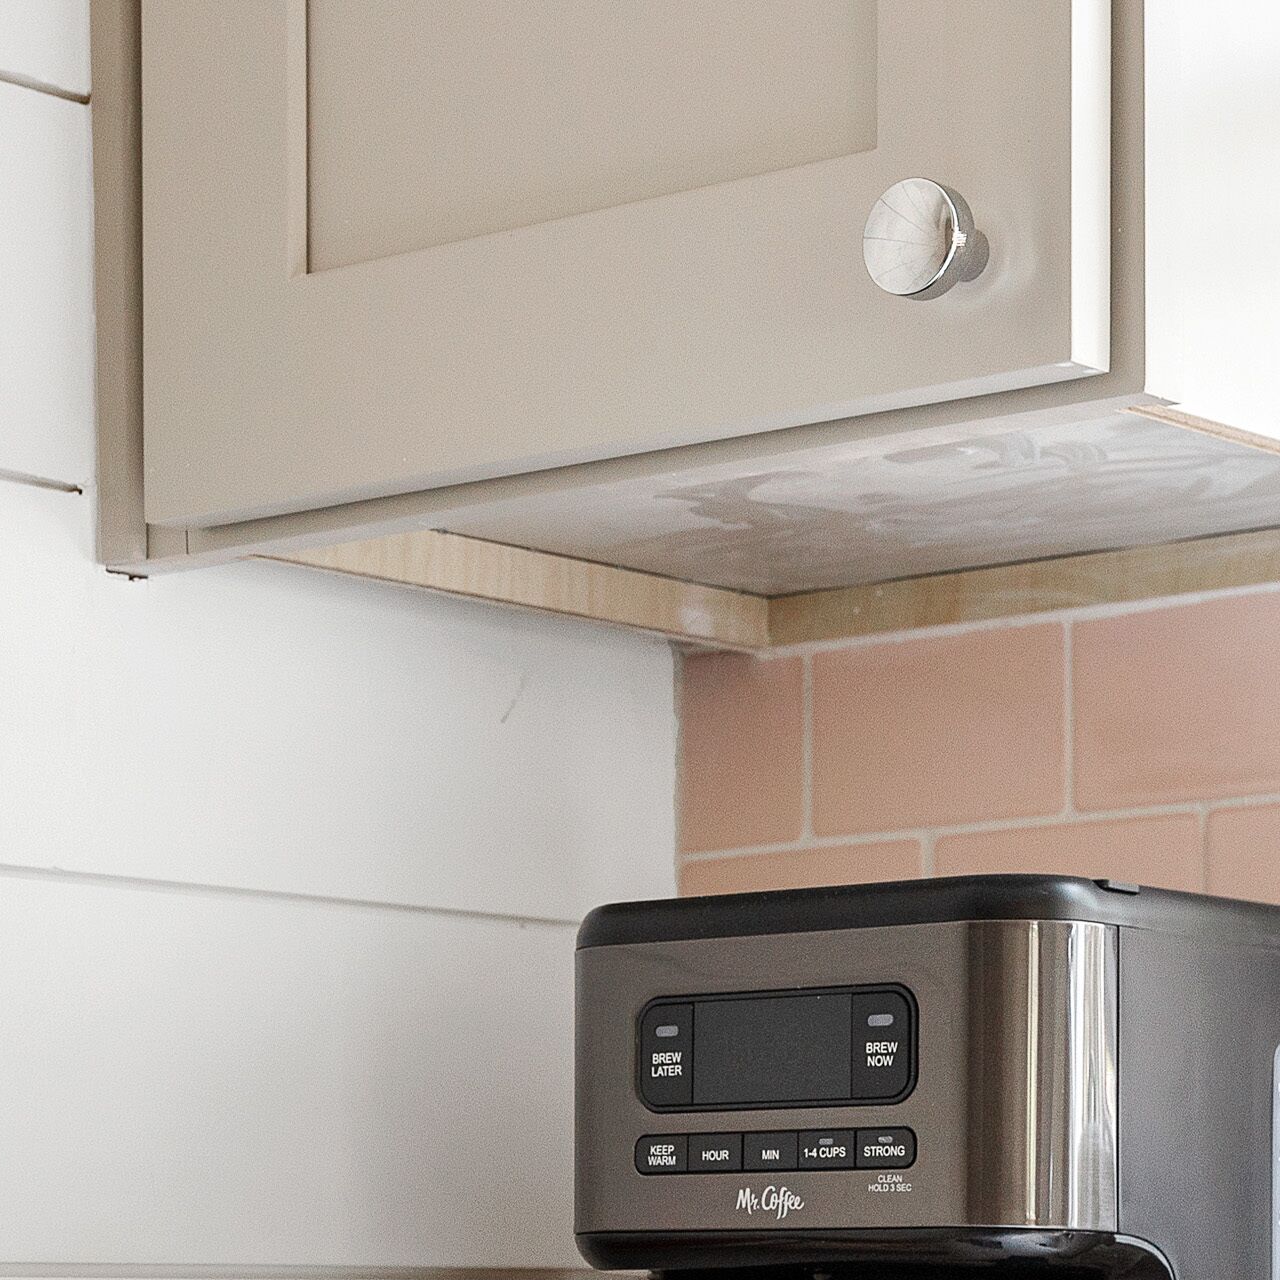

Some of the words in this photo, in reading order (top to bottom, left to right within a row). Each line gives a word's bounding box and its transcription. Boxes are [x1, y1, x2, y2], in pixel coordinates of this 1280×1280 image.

[866, 1042, 898, 1053] BREW
[652, 1052, 682, 1064] BREW
[867, 1055, 894, 1067] NOW
[651, 1065, 682, 1077] LATER
[650, 1145, 675, 1155] KEEP
[702, 1150, 729, 1161] HOUR
[762, 1150, 780, 1160] MIN
[804, 1148, 817, 1158] 1-4
[819, 1147, 846, 1158] CUPS
[863, 1145, 906, 1157] STRONG
[648, 1156, 676, 1166] WARM
[878, 1175, 903, 1183] CLEAN
[868, 1184, 889, 1192] HOLD
[890, 1184, 895, 1192] 3
[897, 1183, 912, 1192] SEC
[736, 1188, 760, 1214] Mr.
[761, 1186, 805, 1219] Coffee
